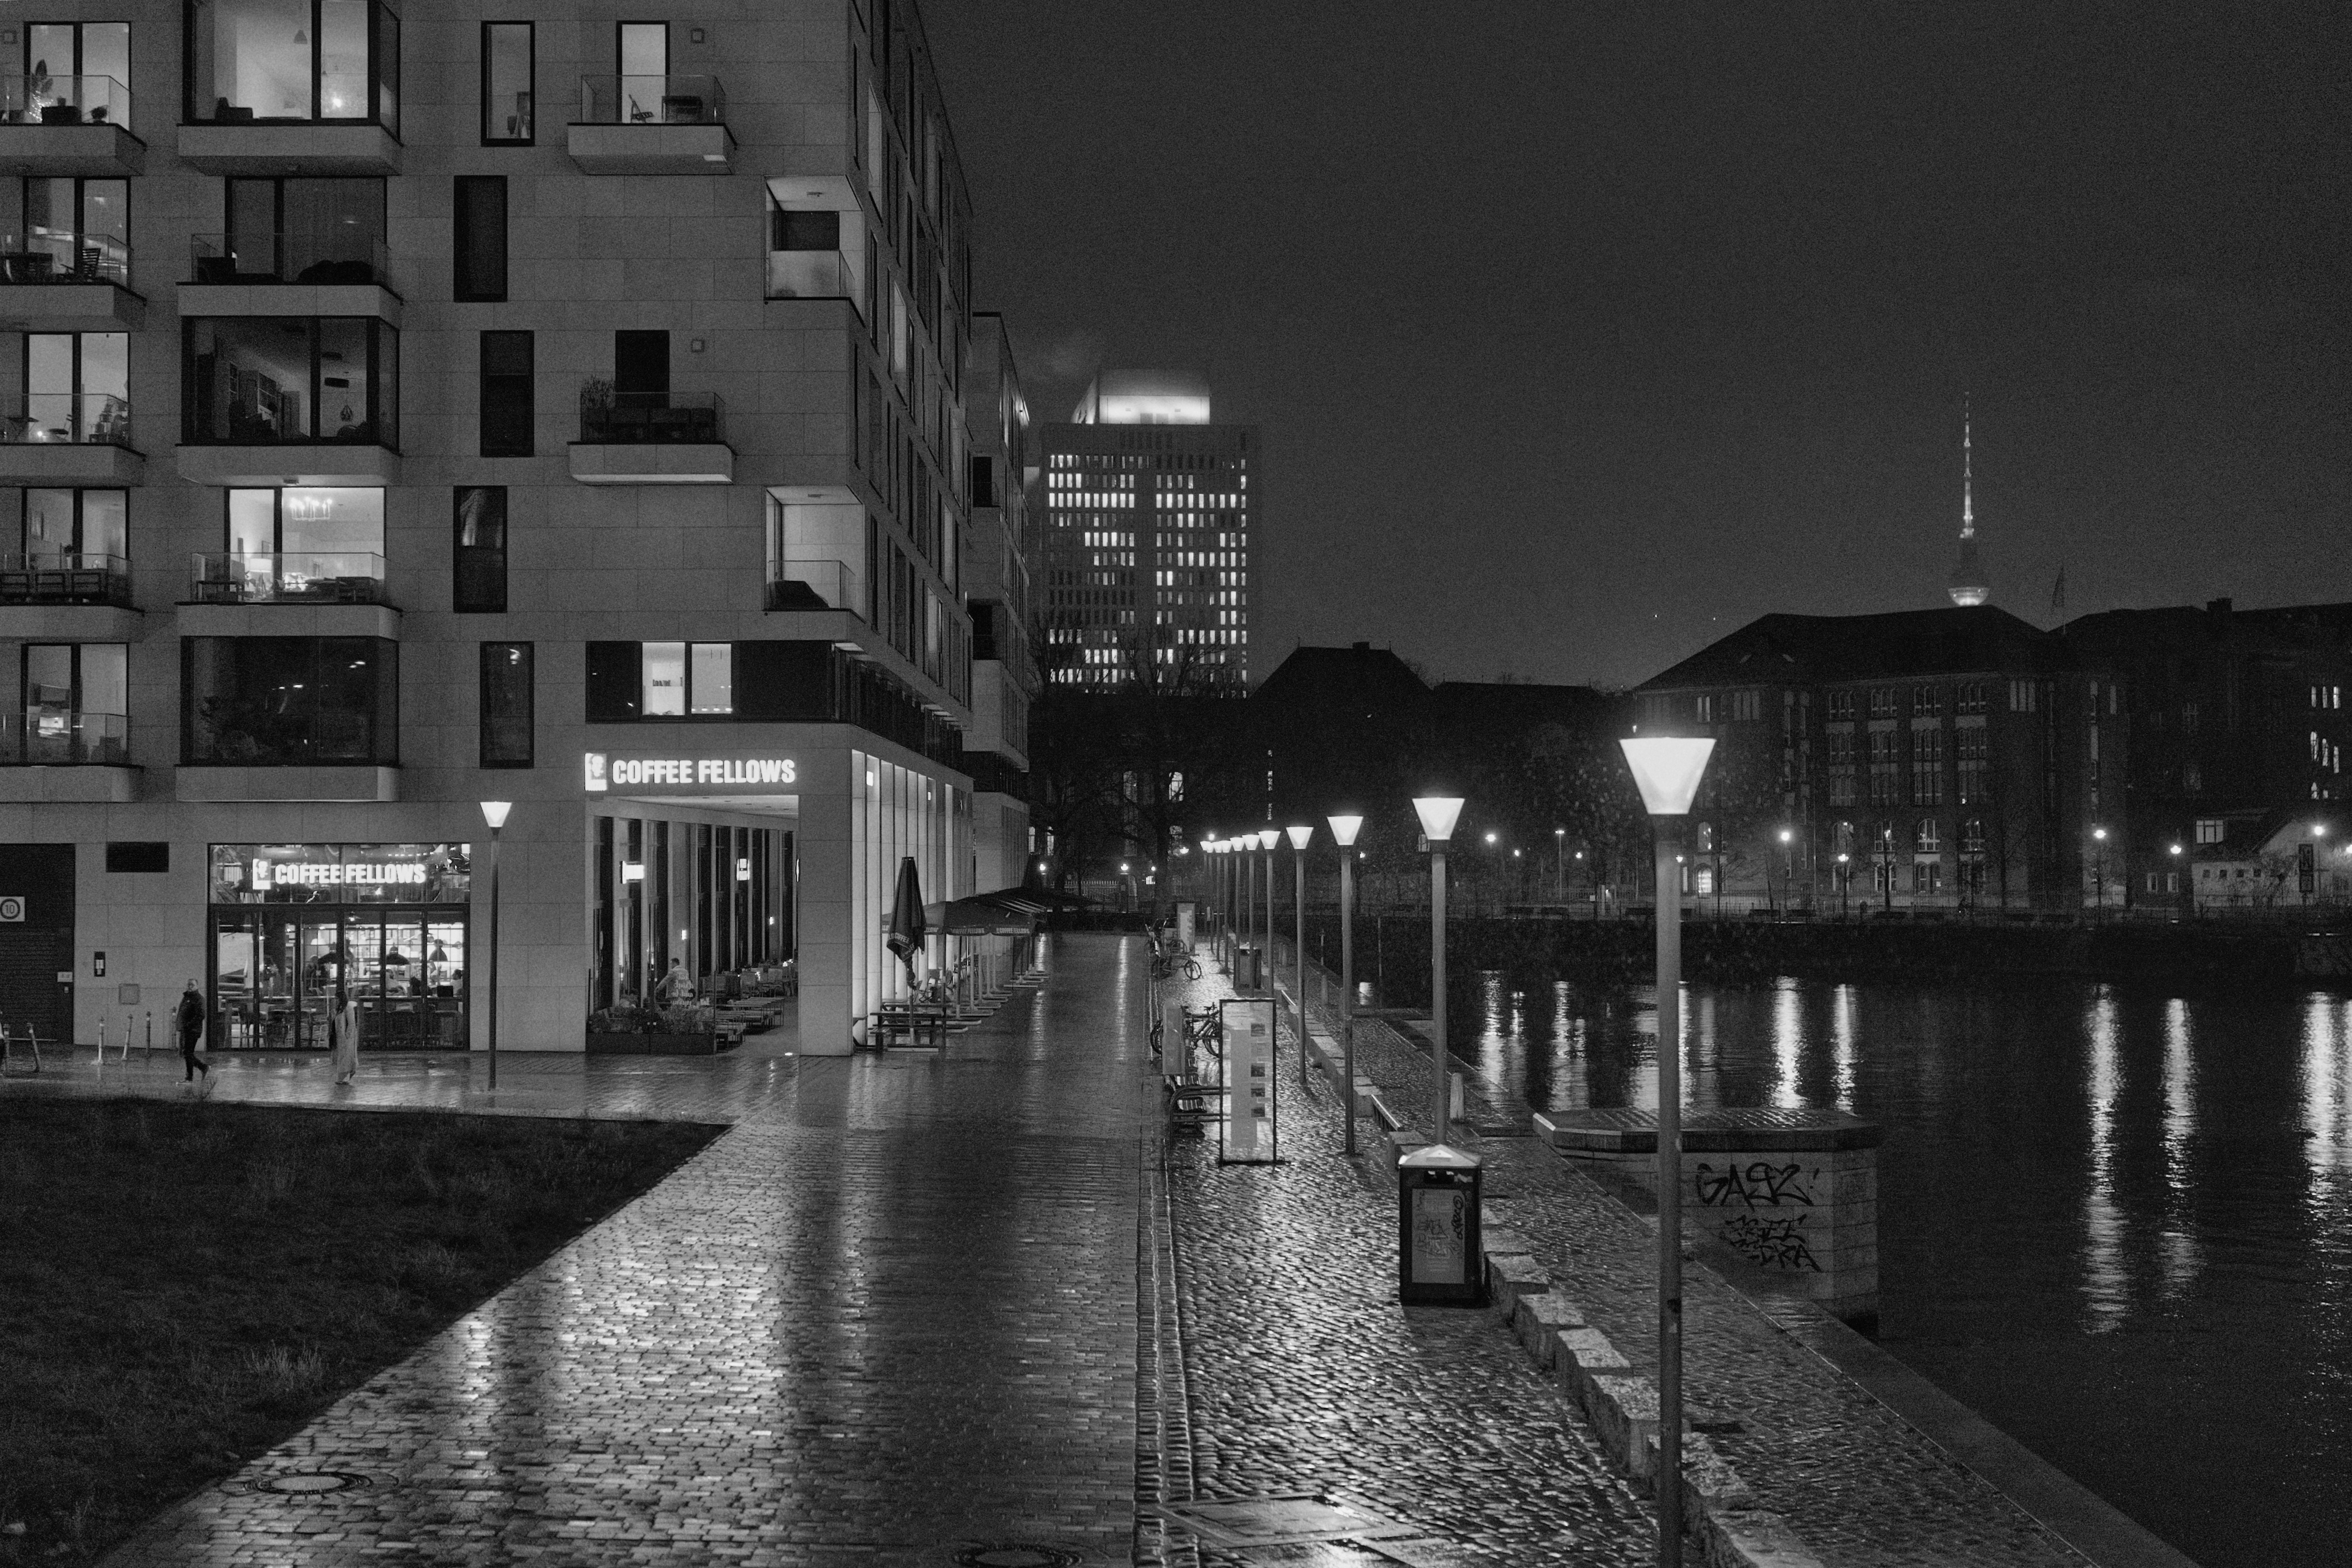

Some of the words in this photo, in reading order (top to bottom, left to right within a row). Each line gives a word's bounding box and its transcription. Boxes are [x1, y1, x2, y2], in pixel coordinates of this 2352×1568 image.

[613, 760, 693, 783] COFFEE
[698, 759, 795, 783] FELLOWS
[275, 864, 340, 883] COFFEE
[345, 864, 426, 883] FELLOWS
[5, 904, 14, 914] 10
